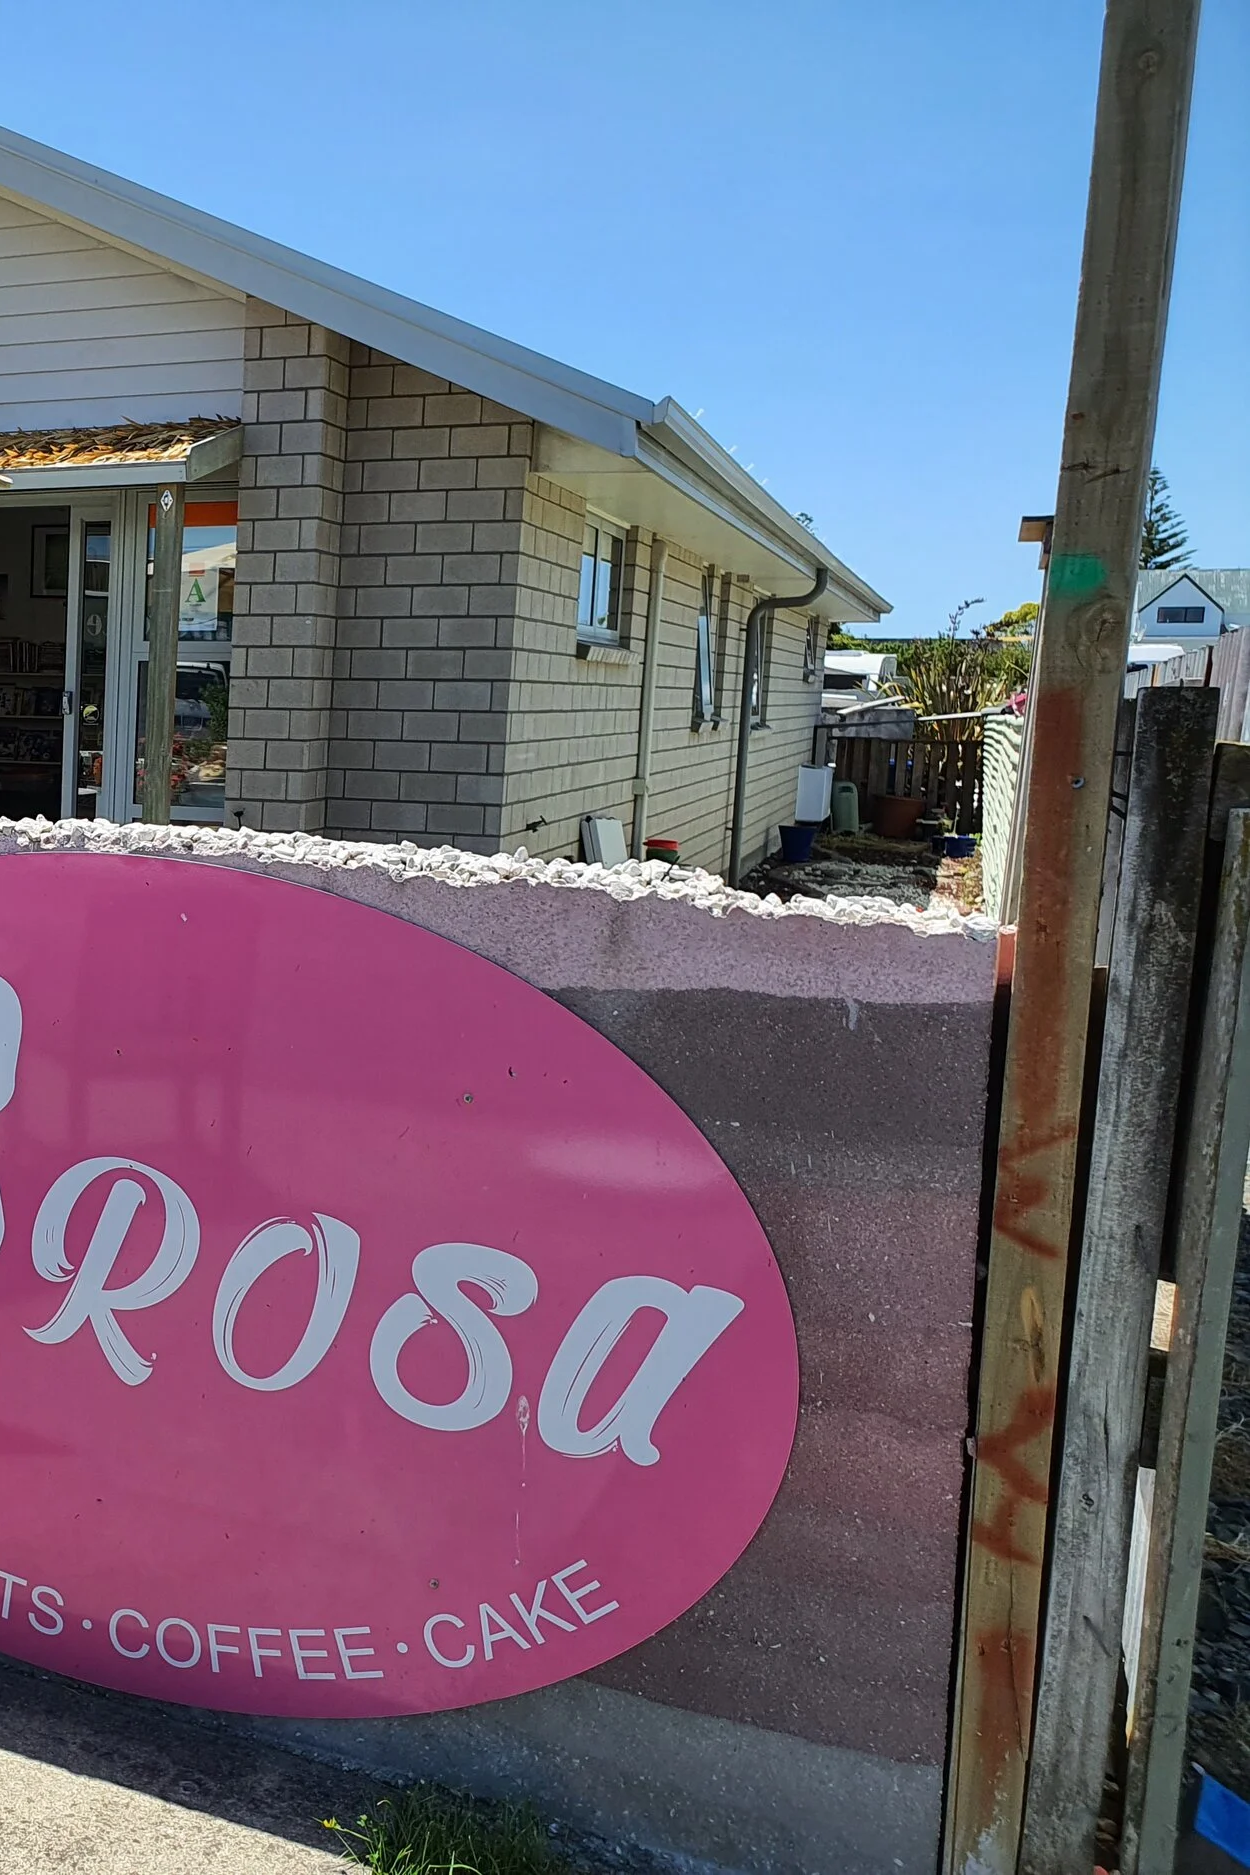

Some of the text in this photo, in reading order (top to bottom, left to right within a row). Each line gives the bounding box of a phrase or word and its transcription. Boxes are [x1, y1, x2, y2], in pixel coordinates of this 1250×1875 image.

[184, 577, 207, 603] A
[108, 1608, 384, 1681] COFFEE
[423, 1558, 620, 1668] CAKE
